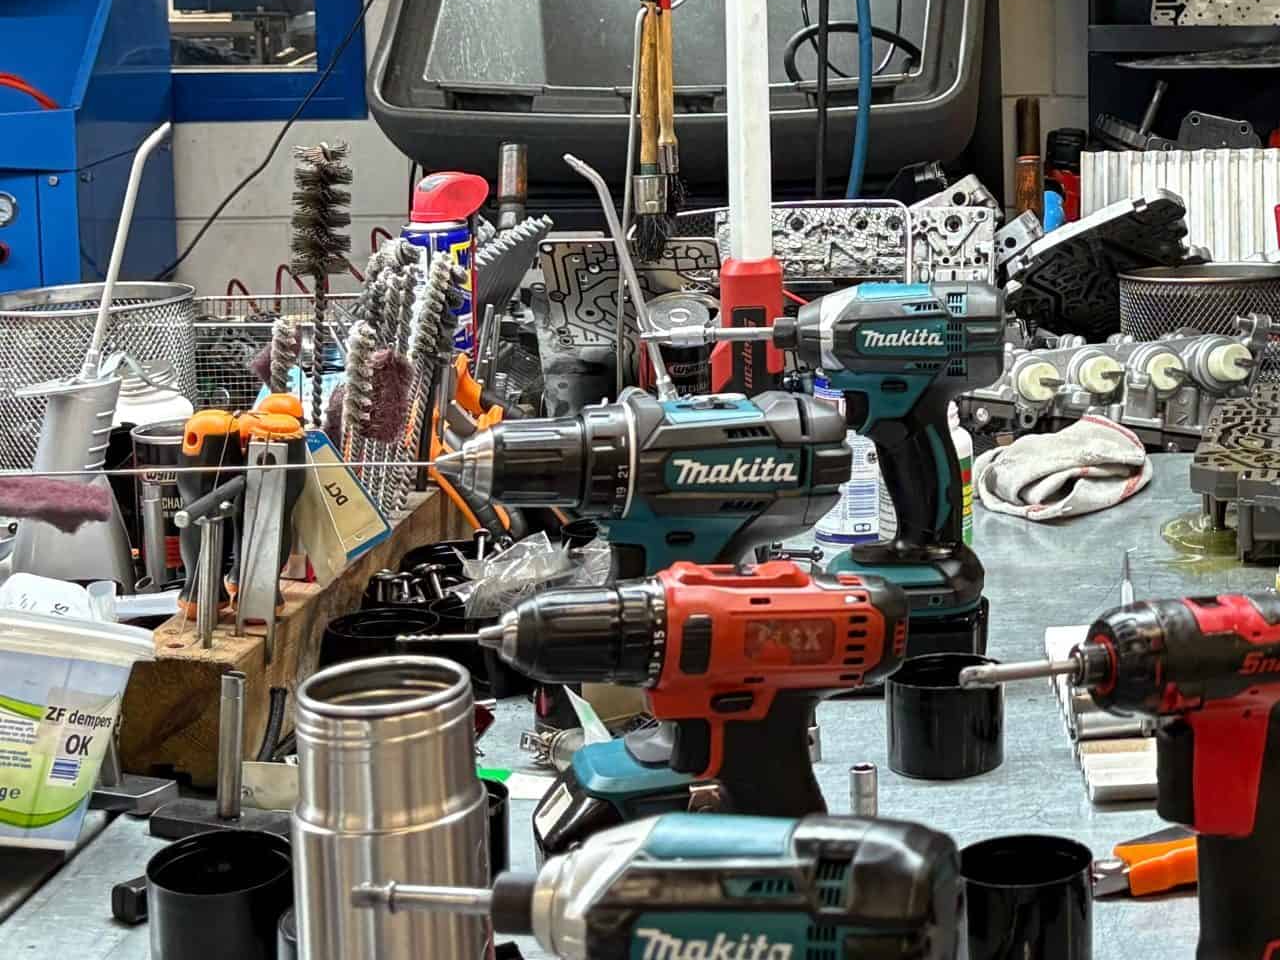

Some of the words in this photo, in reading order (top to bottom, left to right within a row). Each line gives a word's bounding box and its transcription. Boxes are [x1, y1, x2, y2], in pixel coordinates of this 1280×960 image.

[617, 464, 629, 479] 21
[324, 481, 349, 507] DCT
[653, 630, 665, 646] 15
[45, 705, 66, 723] ZF
[68, 709, 113, 731] dempers
[65, 734, 93, 756] OK
